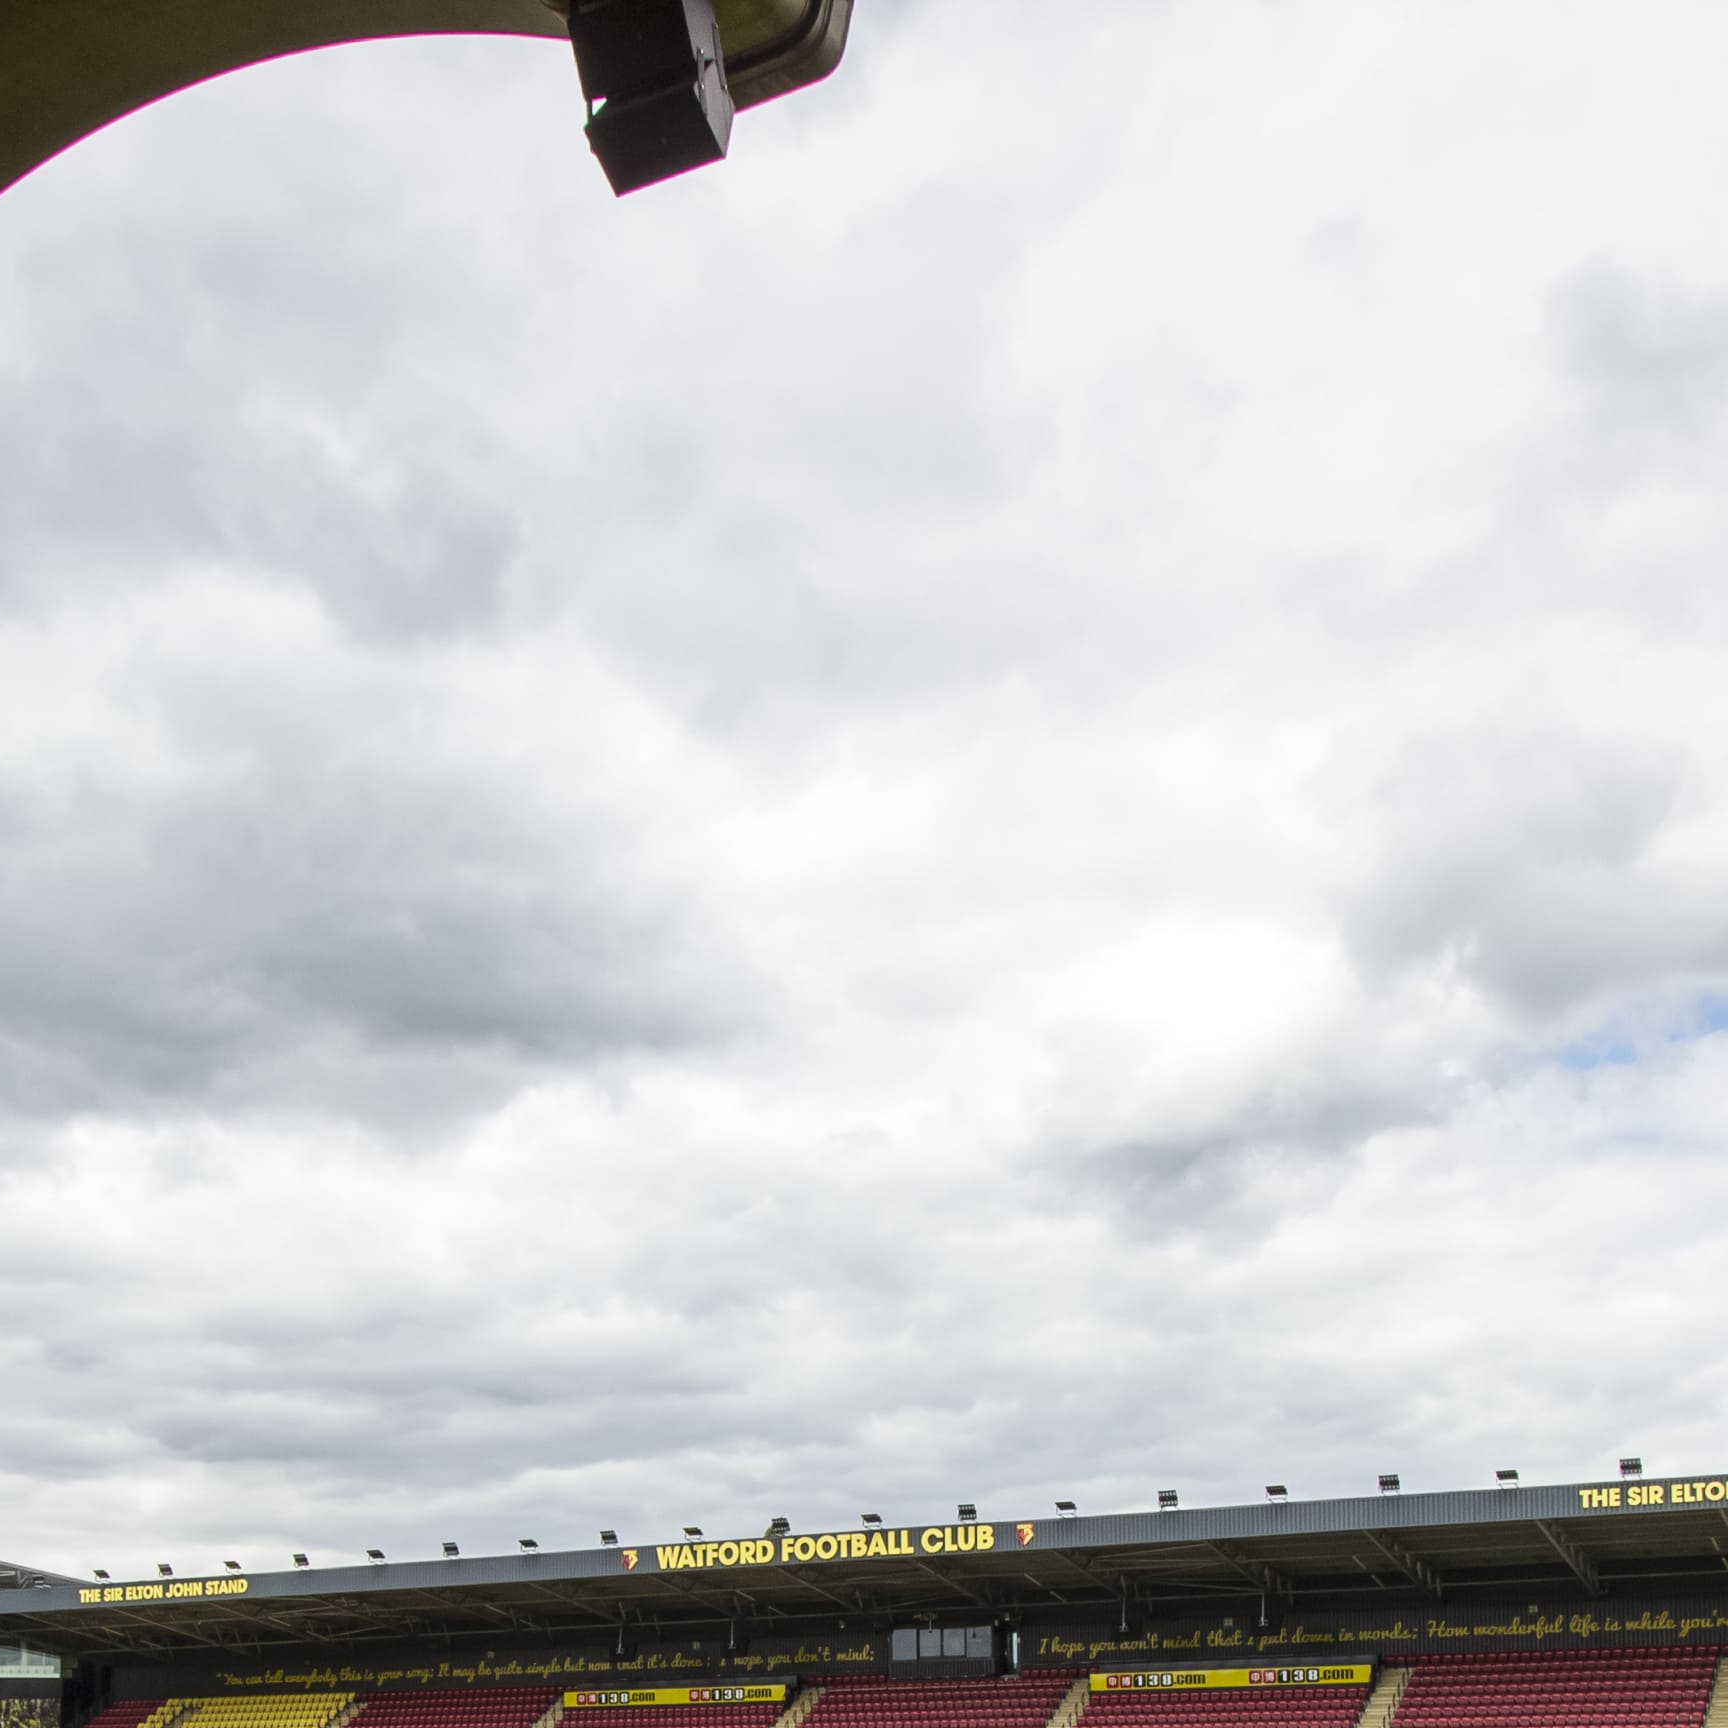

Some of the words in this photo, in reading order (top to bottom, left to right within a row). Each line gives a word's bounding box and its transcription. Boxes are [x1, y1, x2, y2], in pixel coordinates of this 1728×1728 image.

[1579, 1487, 1621, 1509] THE
[1627, 1485, 1664, 1507] SIR
[656, 1539, 774, 1571] WATFORD
[781, 1530, 914, 1563] FOOTBALL
[920, 1525, 995, 1553] CLUB
[79, 1589, 101, 1603] THE
[103, 1587, 123, 1601] SIR
[125, 1585, 163, 1600] ELTON
[165, 1582, 203, 1598] JOHN
[205, 1579, 248, 1595] STAND
[1040, 1638, 1049, 1654] I
[1051, 1636, 1085, 1659] hope
[1089, 1640, 1118, 1659] you
[1163, 1631, 1201, 1649] mind
[1206, 1630, 1243, 1647] that
[1259, 1628, 1287, 1651] put
[1291, 1626, 1334, 1644] down
[1339, 1628, 1355, 1642] in
[1428, 1620, 1471, 1638] How
[1473, 1615, 1564, 1639] wonderful
[1570, 1614, 1600, 1638] life
[1604, 1617, 1622, 1632] is
[1625, 1610, 1676, 1630] while
[285, 1667, 337, 1688] everybody
[339, 1666, 363, 1681] this
[377, 1671, 403, 1686] your
[453, 1667, 474, 1683] may
[493, 1659, 523, 1680] quite
[525, 1657, 561, 1679] simple
[564, 1656, 585, 1673] but
[767, 1655, 791, 1671] you
[794, 1646, 831, 1663] don't
